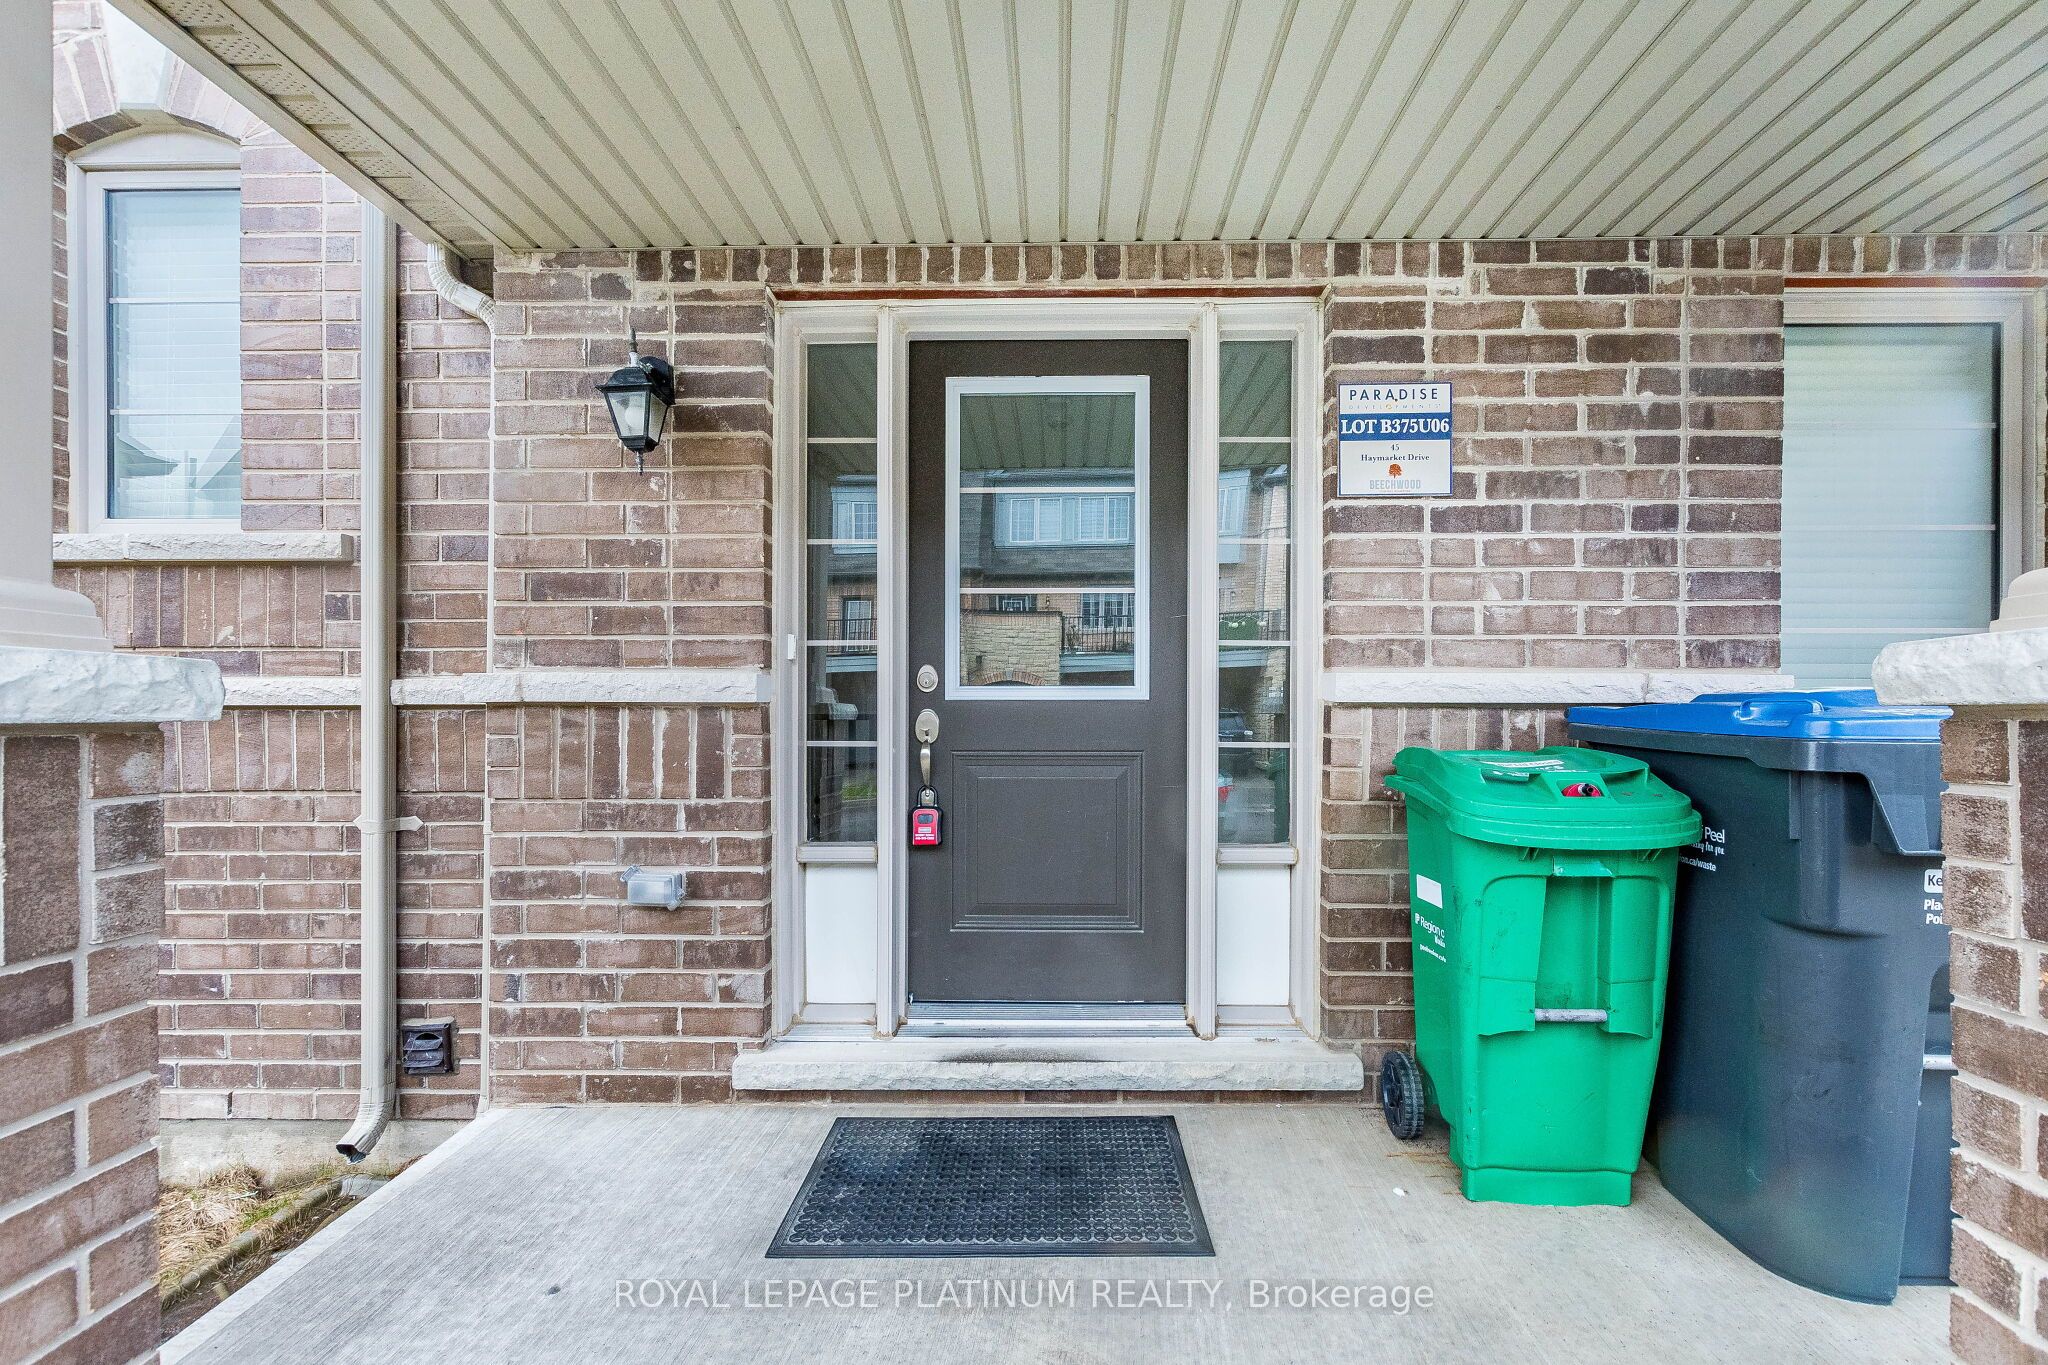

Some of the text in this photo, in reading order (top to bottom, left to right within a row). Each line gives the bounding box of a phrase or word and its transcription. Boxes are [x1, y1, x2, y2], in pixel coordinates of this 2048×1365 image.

[1349, 388, 1438, 400] PARADISE
[1340, 418, 1450, 434] LOT B375U06
[1361, 453, 1430, 463] Haymarket Drive
[1369, 480, 1421, 490] BEECHWOOD
[1704, 826, 1725, 844] Peel
[1923, 898, 1944, 911] Pla
